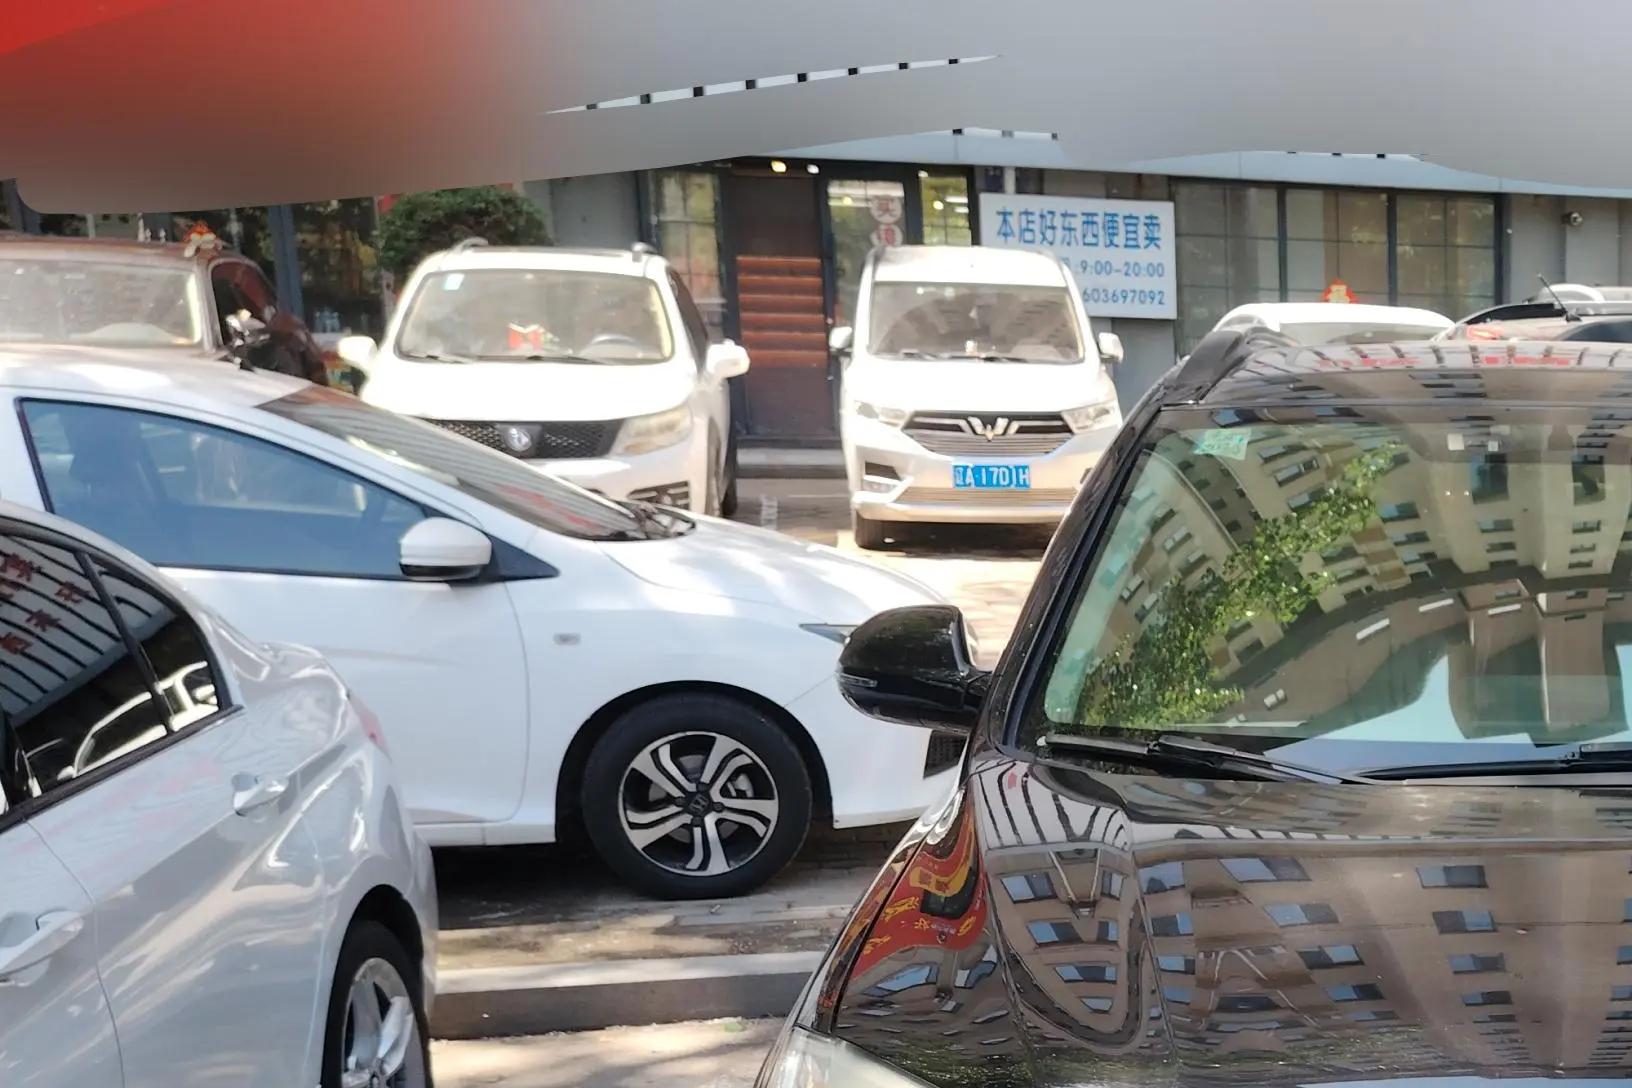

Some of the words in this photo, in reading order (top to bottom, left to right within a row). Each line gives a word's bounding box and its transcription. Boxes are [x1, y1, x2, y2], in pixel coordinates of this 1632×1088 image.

[995, 208, 1163, 250] 本店好东西便宜卖
